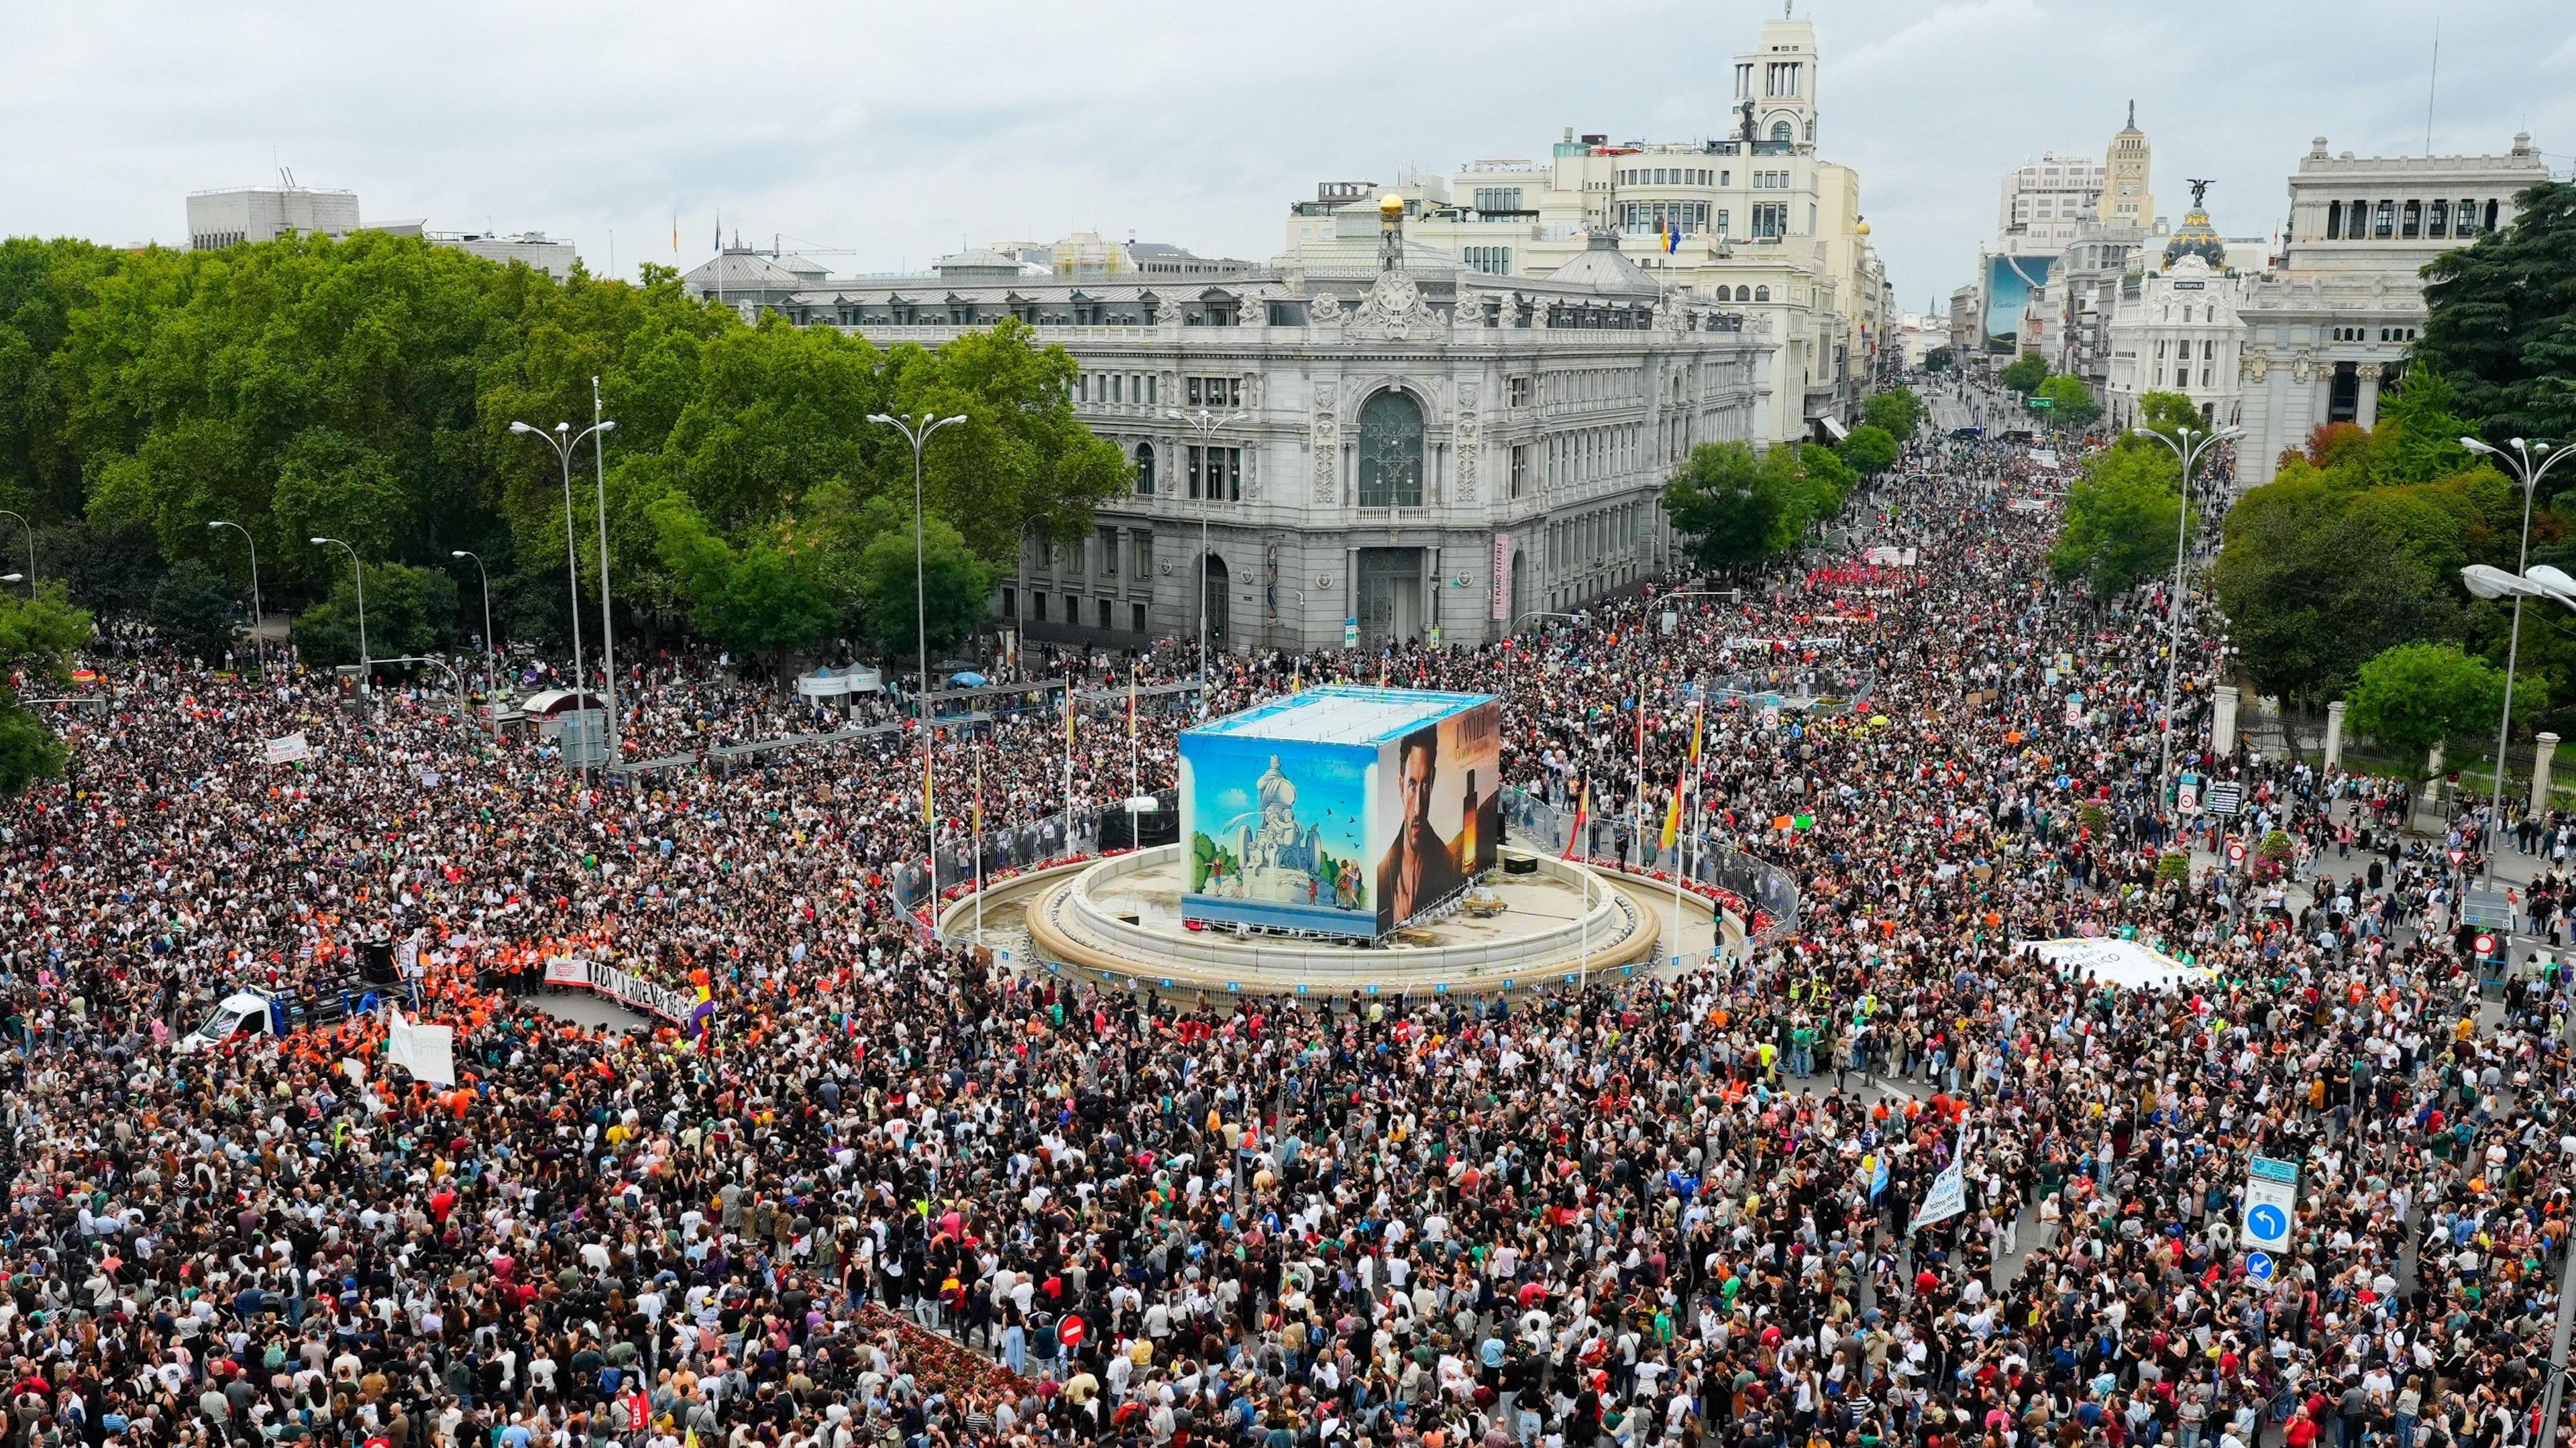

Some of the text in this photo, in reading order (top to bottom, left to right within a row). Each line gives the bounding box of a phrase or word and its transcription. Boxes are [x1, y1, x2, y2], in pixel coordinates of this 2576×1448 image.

[1994, 300, 2017, 308] Cartier
[1456, 712, 1488, 749] I WILL
[2252, 1169, 2294, 1182] Distrito Centro
